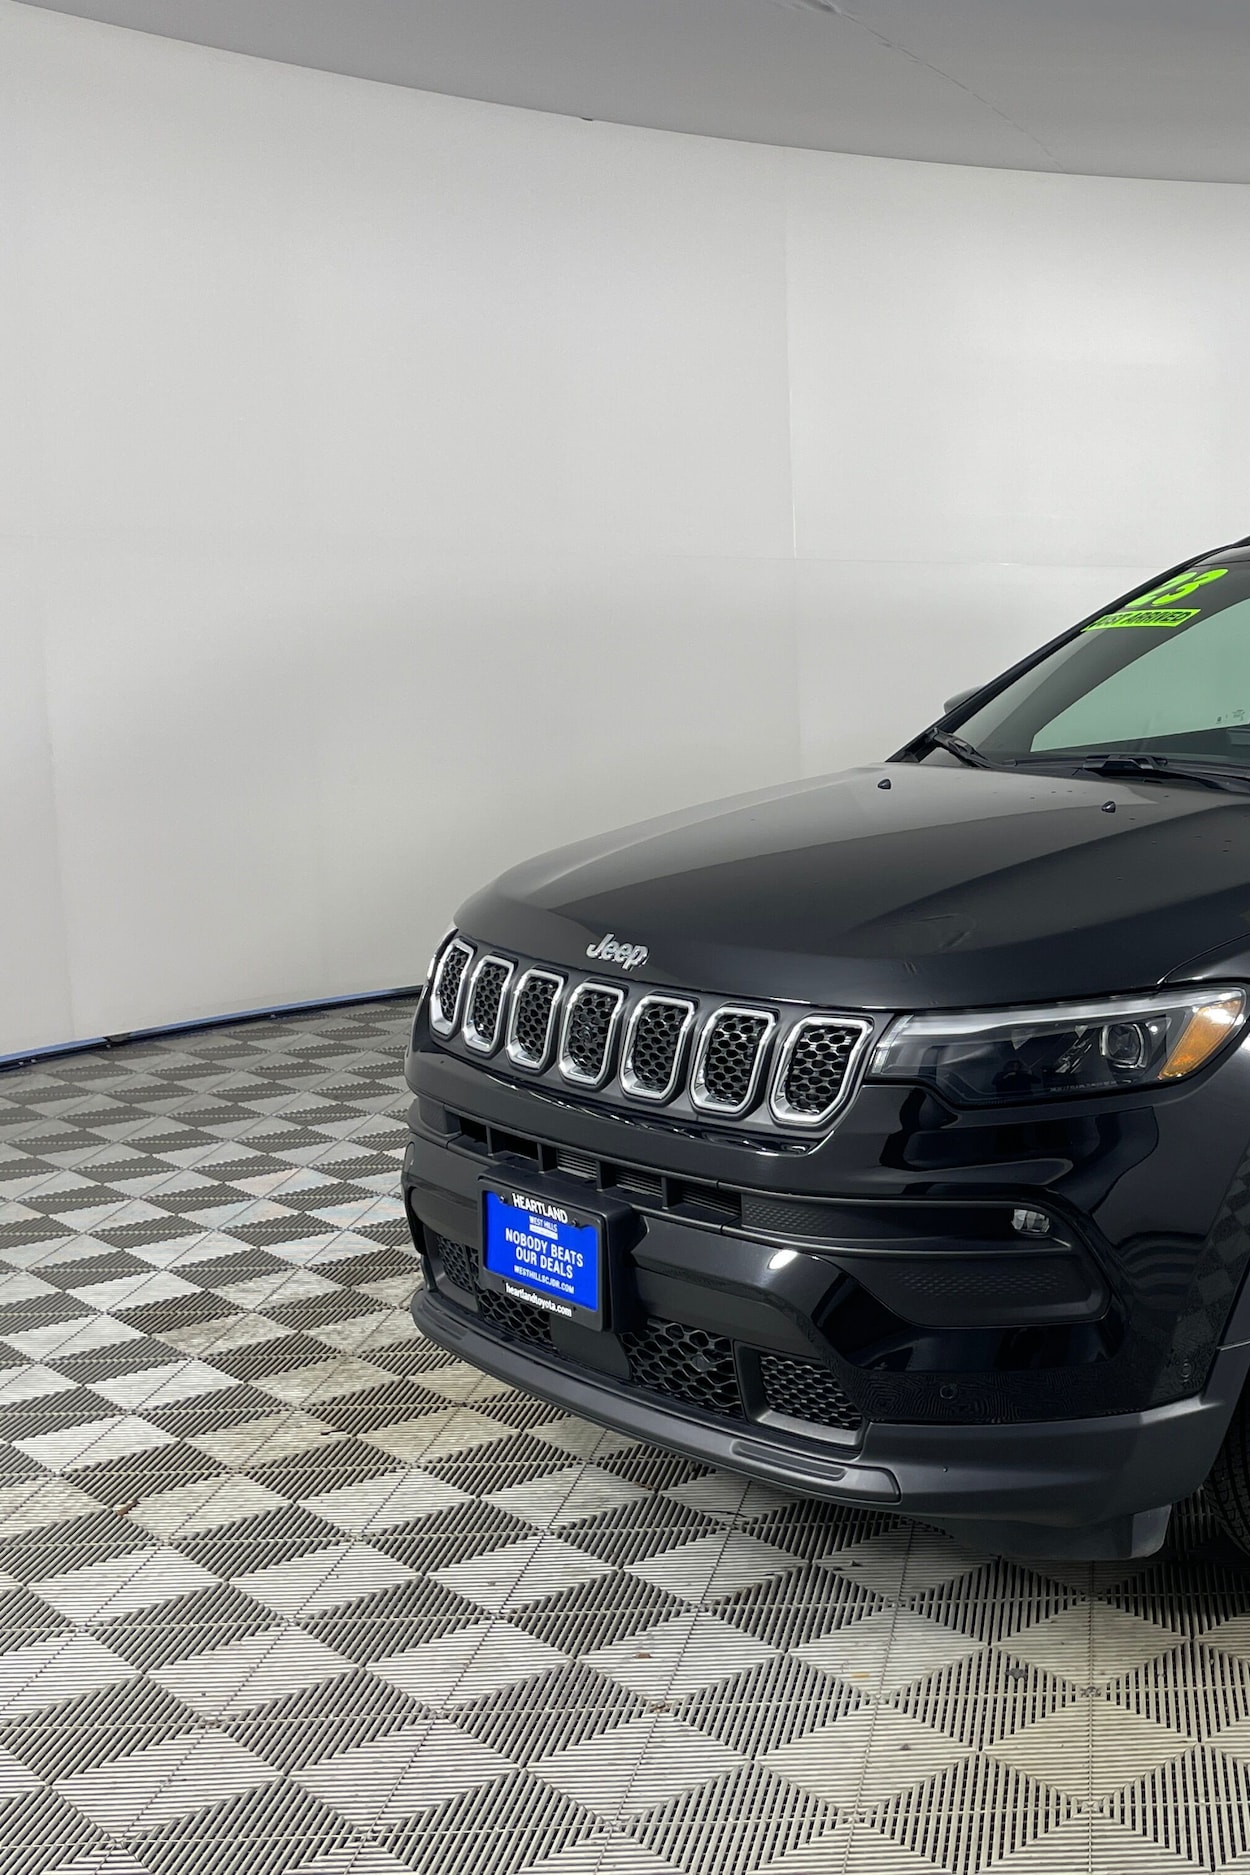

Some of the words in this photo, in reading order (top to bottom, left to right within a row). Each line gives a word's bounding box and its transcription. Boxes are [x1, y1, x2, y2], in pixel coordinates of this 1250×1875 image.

[586, 933, 649, 971] Jeep
[511, 1192, 569, 1224] HEARTLAND
[528, 1215, 543, 1227] WEST
[505, 1227, 548, 1254] NOBODY
[550, 1244, 584, 1268] BEATS
[515, 1246, 537, 1267] OUR
[540, 1255, 573, 1279] DEALS
[513, 1265, 575, 1294] WESTHILLSCJDR.COM
[505, 1282, 573, 1318] heartlandtoyota.com
